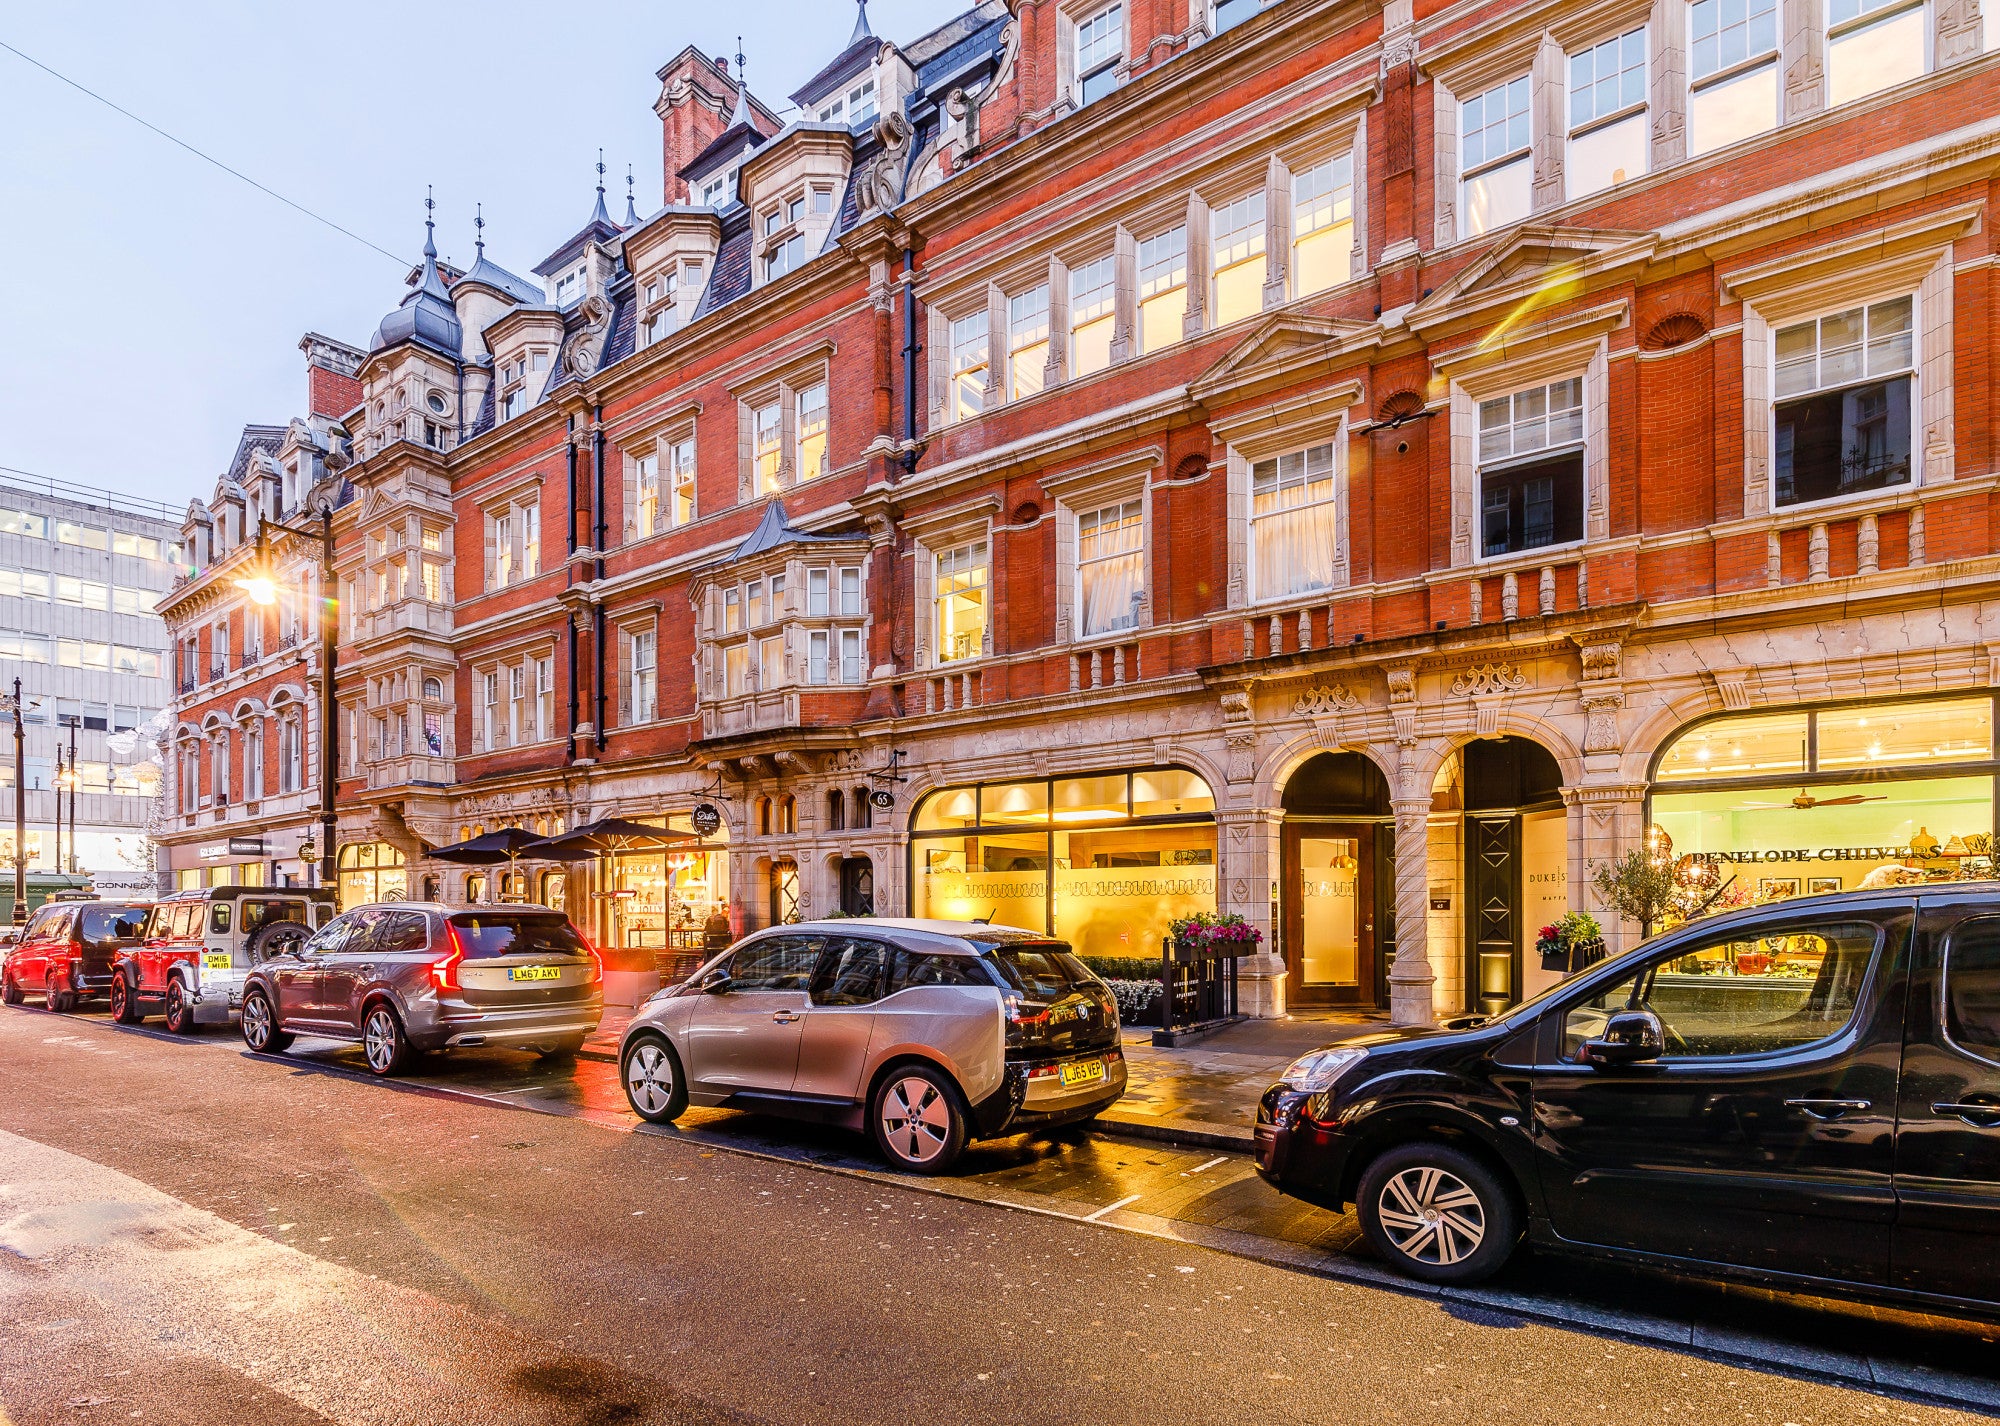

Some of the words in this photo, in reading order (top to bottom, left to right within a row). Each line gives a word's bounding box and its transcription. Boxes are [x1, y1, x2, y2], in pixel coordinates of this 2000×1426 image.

[877, 794, 888, 805] 65
[1692, 849, 1811, 865] PENELOPE
[1818, 845, 1942, 861] CHILVERS
[615, 864, 659, 877] JIGSAW
[1530, 873, 1557, 882] DUKE
[208, 955, 228, 963] DM16
[514, 969, 539, 980] LM67
[542, 968, 559, 978] AKV
[1065, 1065, 1087, 1082] LJ65
[1087, 1061, 1101, 1077] VEP
